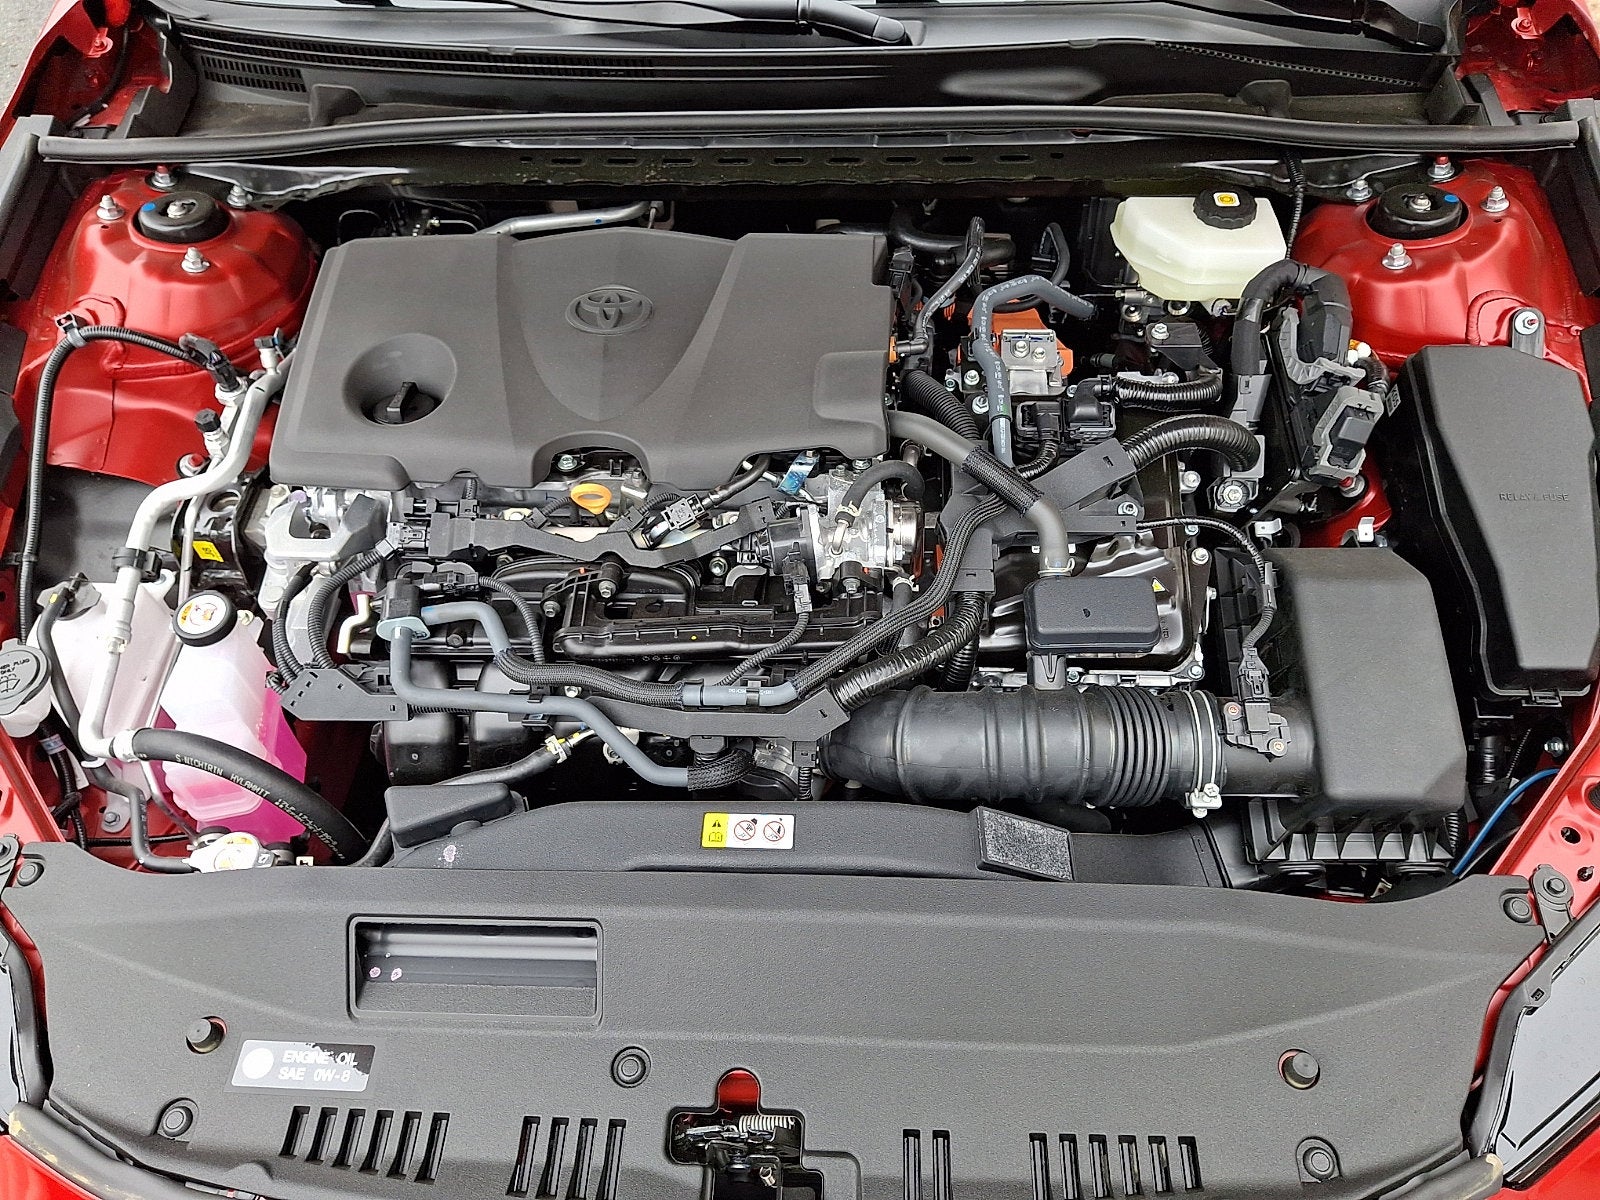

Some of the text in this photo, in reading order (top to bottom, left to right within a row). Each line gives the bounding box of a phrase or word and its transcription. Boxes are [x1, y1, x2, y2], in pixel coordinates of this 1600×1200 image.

[1498, 493, 1569, 501] RELAY FUSE
[282, 1049, 359, 1066] ENGINE OIL
[278, 1066, 351, 1083] SAE 0W-8
